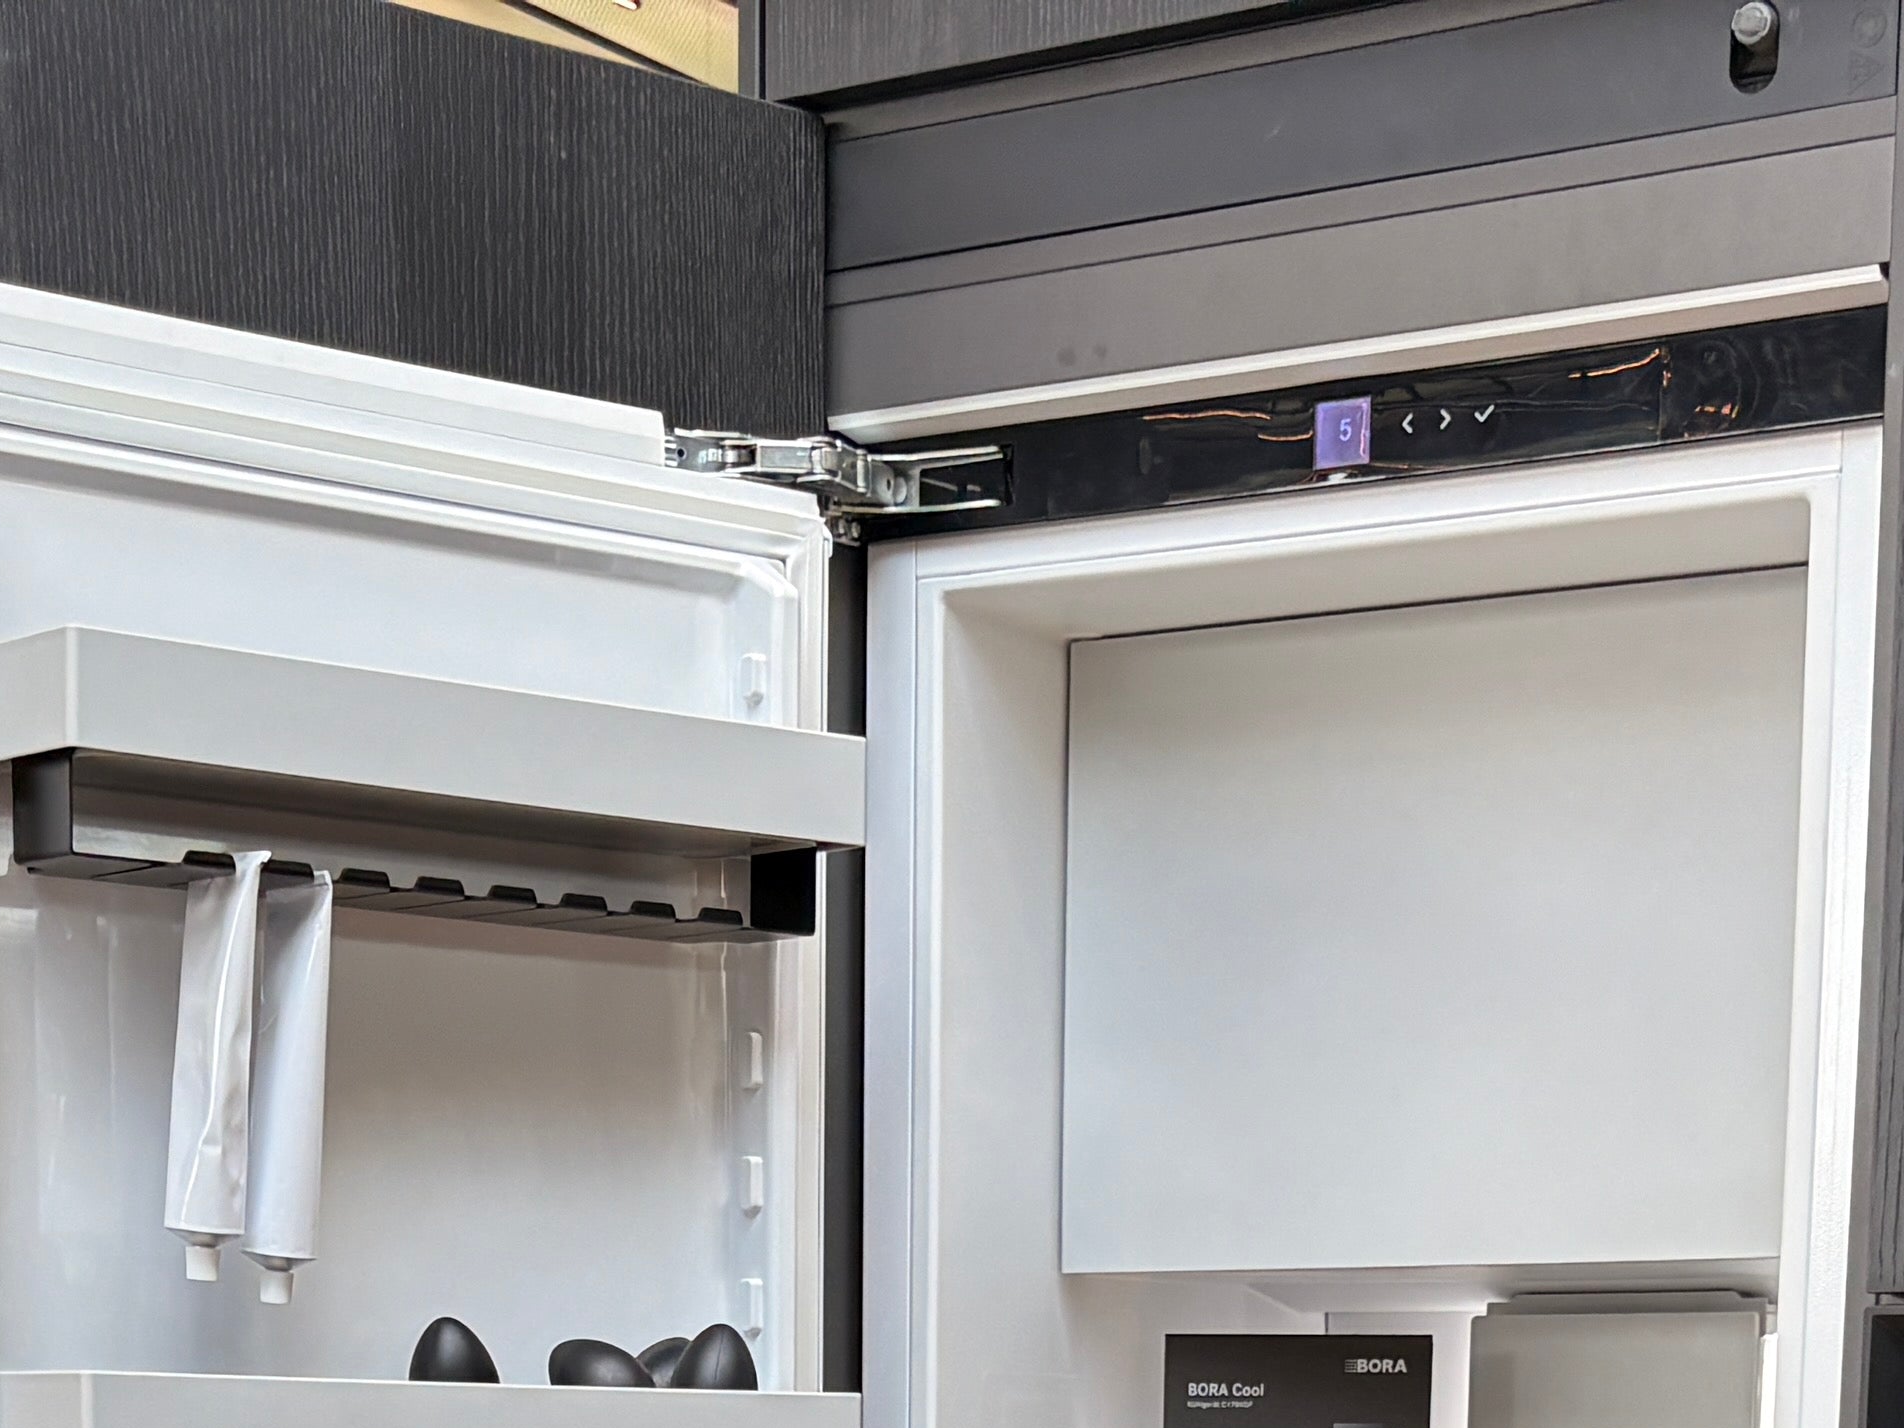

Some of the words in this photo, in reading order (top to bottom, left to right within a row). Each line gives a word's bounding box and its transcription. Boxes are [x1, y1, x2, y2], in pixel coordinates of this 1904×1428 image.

[1339, 418, 1352, 441] 5
[1355, 1358, 1408, 1374] BORA
[1187, 1382, 1229, 1397] BORA
[1231, 1382, 1265, 1397] Cool
